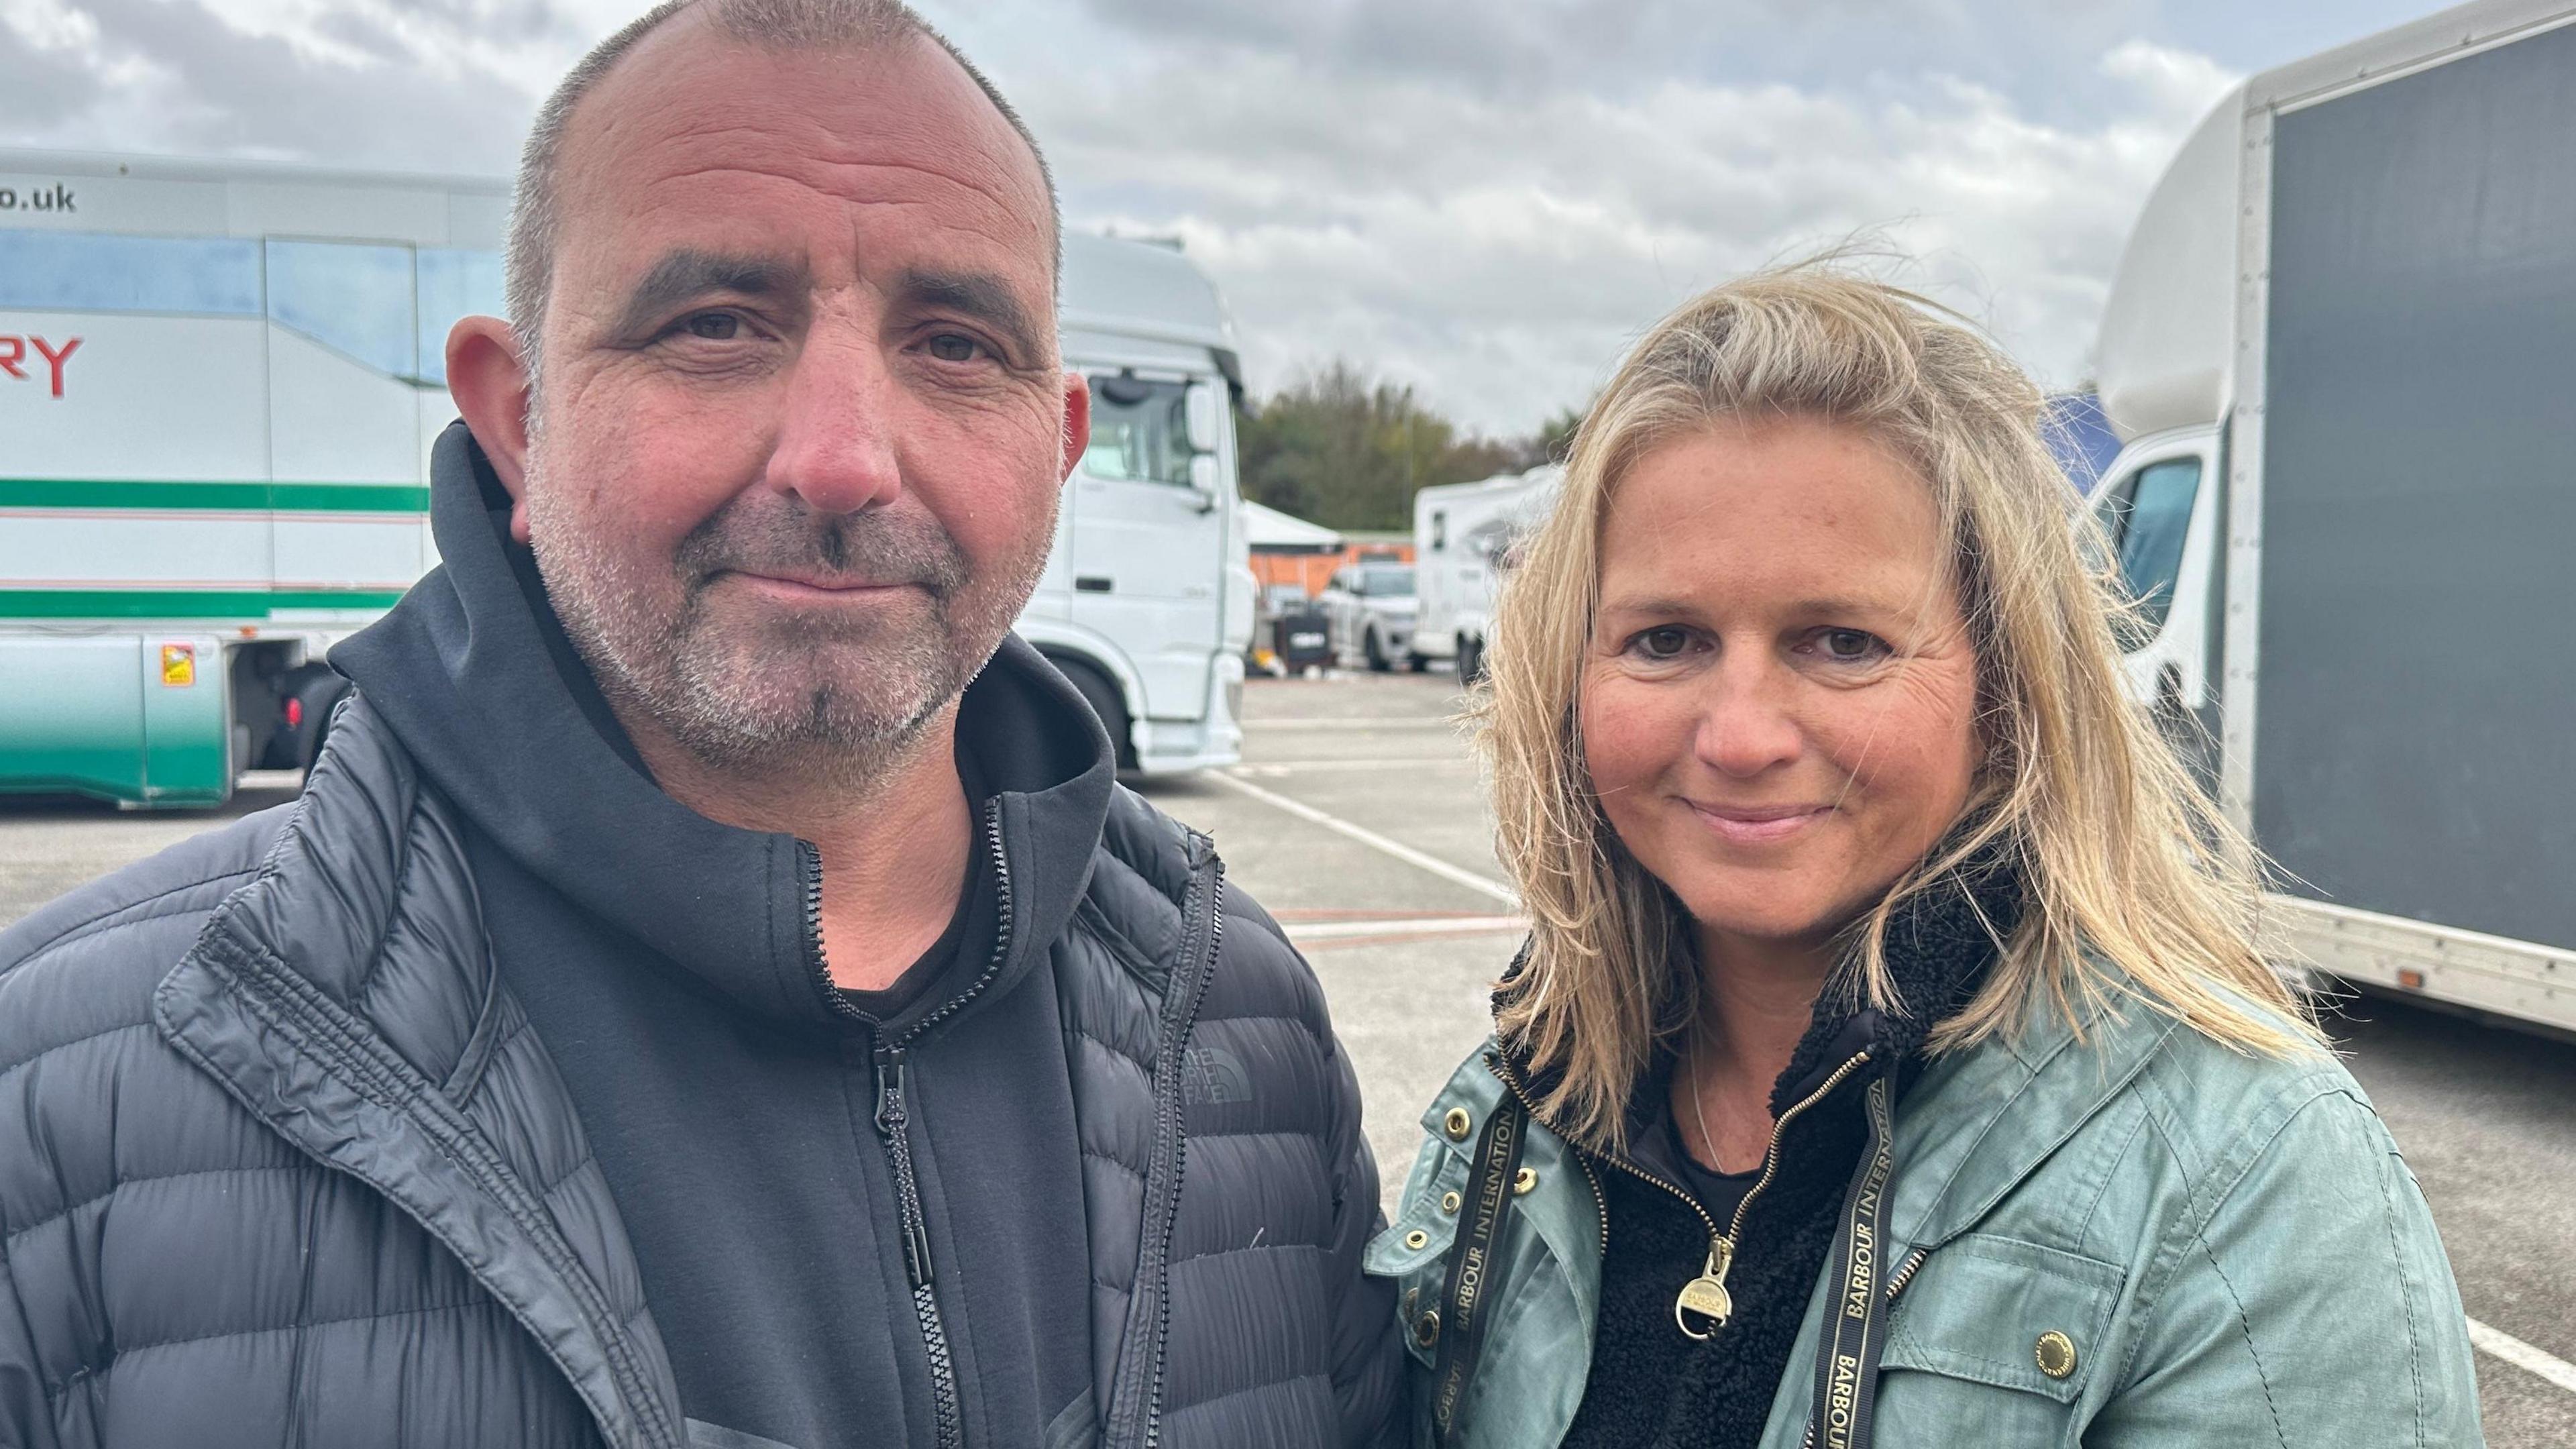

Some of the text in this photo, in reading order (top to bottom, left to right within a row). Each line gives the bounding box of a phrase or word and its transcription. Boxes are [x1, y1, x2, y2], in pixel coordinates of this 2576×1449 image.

[0, 182, 76, 213] o.uk
[0, 335, 85, 399] RY
[1456, 1107, 1513, 1332] BARBOUR INTERNATION
[1846, 1223, 1873, 1319] BARBOUR
